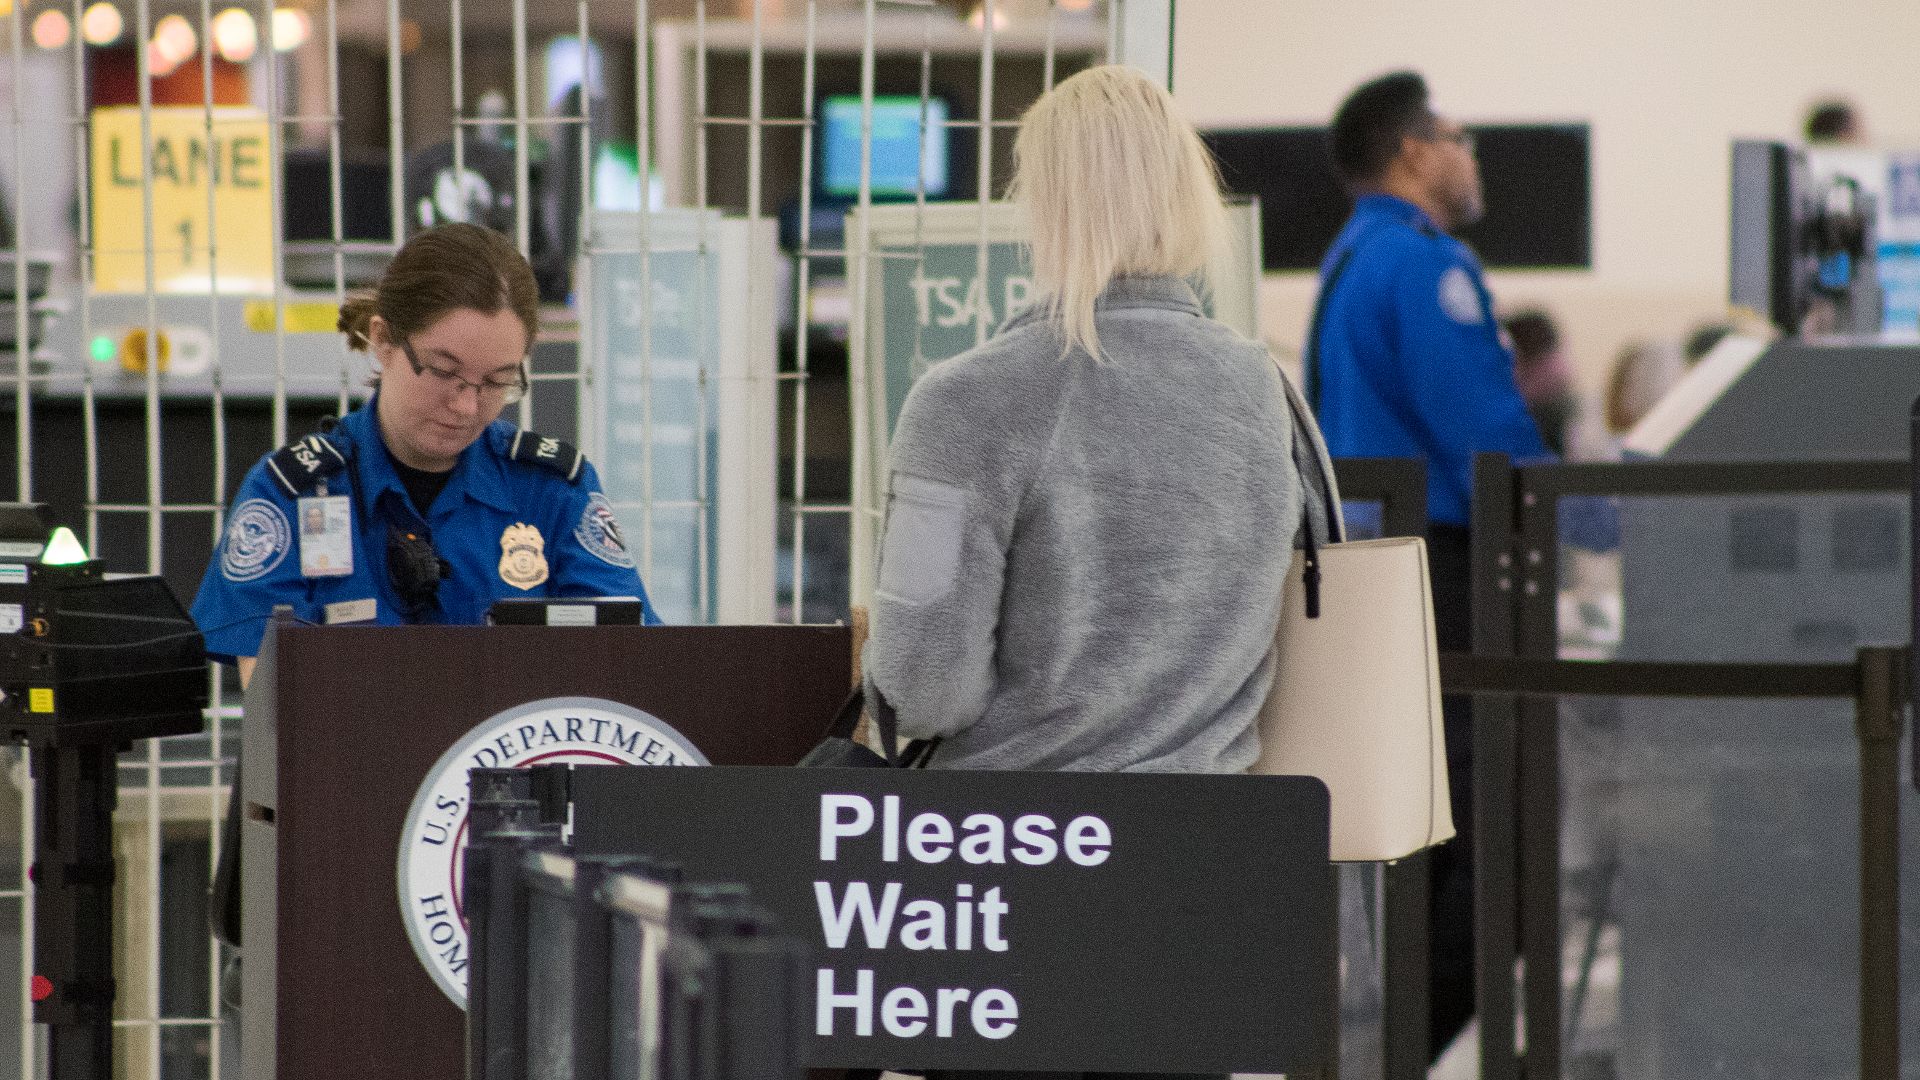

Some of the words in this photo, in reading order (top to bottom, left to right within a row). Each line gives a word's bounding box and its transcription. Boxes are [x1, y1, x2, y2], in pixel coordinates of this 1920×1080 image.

[110, 137, 262, 188] LANE
[176, 219, 194, 266] 1
[910, 276, 994, 327] TSA
[290, 441, 321, 473] TSA
[536, 437, 560, 458] TSA
[422, 794, 465, 845] U.S.
[473, 717, 686, 766] DEPARTME
[819, 794, 1112, 866] Please
[420, 894, 468, 986] HOM
[814, 881, 1009, 952] Wait
[816, 968, 1019, 1039] Here
